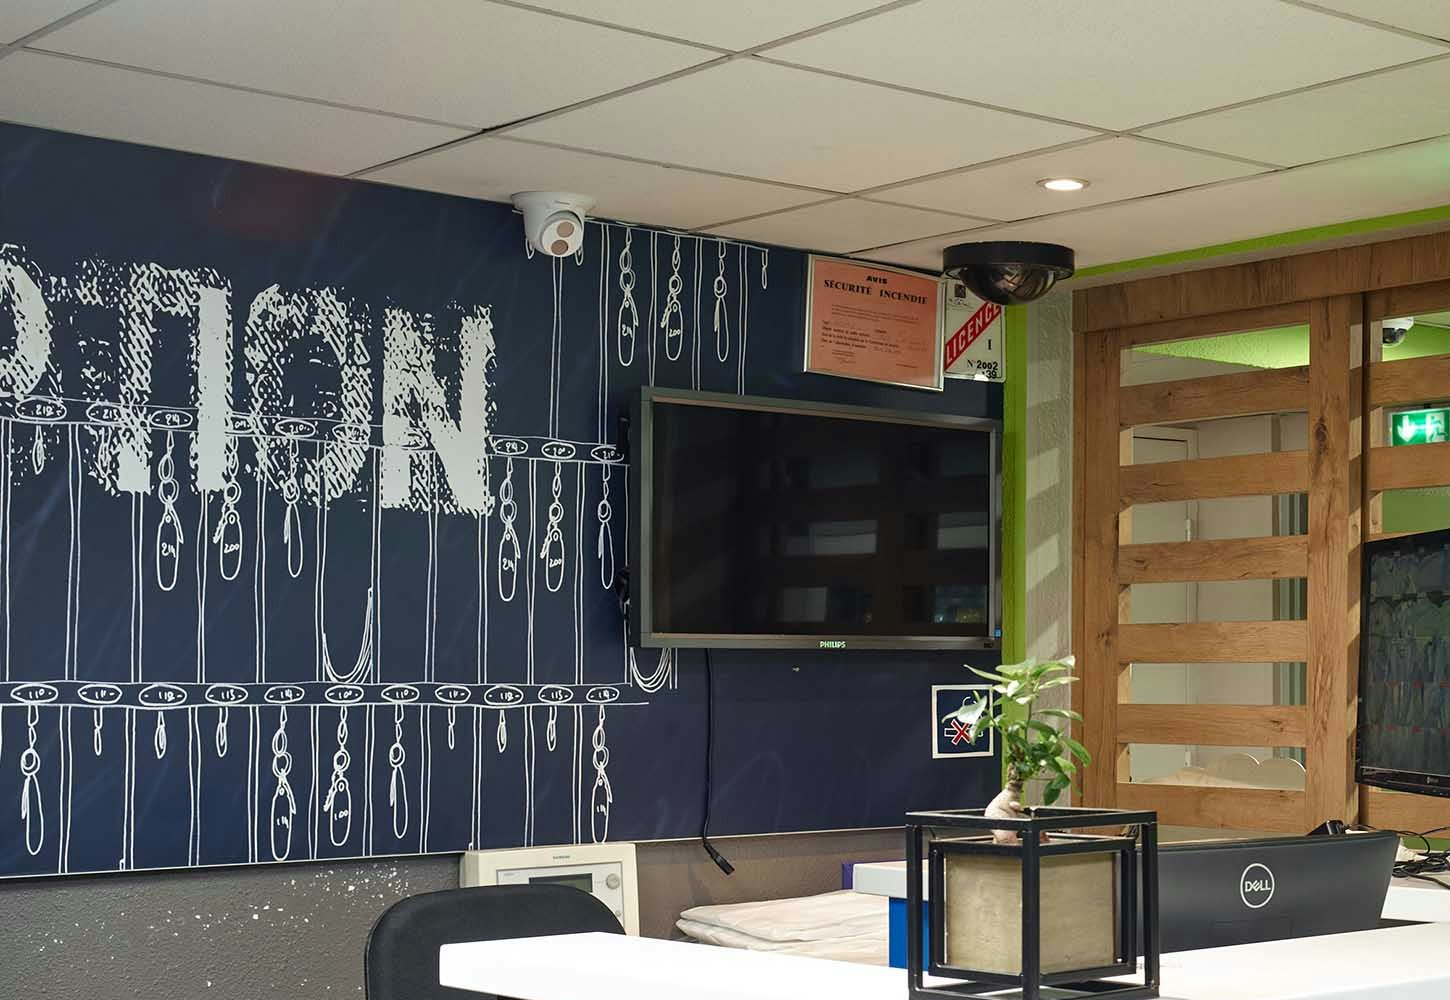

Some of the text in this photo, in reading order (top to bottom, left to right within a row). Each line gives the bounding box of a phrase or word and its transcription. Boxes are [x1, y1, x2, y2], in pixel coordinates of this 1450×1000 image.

[879, 288, 928, 305] INCENDIE
[819, 640, 847, 649] PHILIPS
[1244, 879, 1271, 892] DELL
